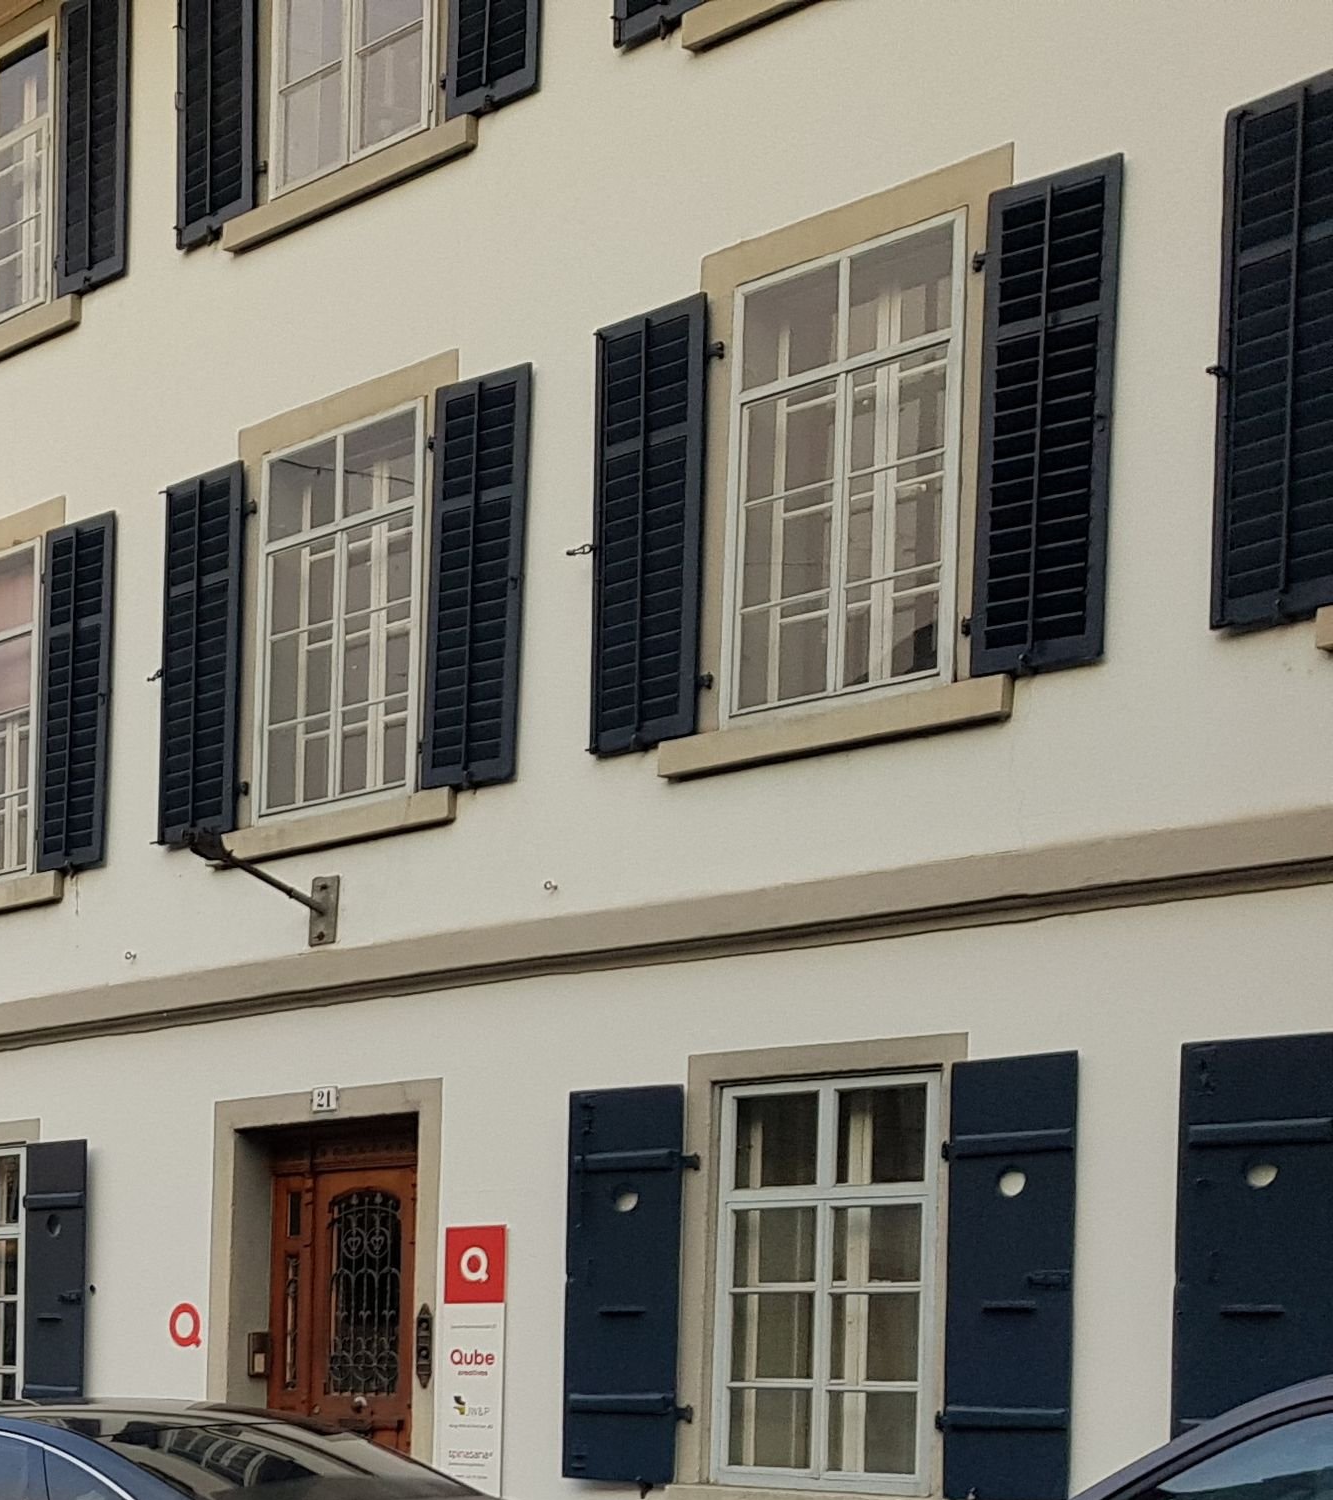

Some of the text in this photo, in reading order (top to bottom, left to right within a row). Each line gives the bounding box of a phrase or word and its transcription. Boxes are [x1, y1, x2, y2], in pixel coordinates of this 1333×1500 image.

[317, 1090, 331, 1108] 21
[460, 1247, 489, 1283] Q
[169, 1303, 202, 1347] Q
[450, 1348, 495, 1366] Qube
